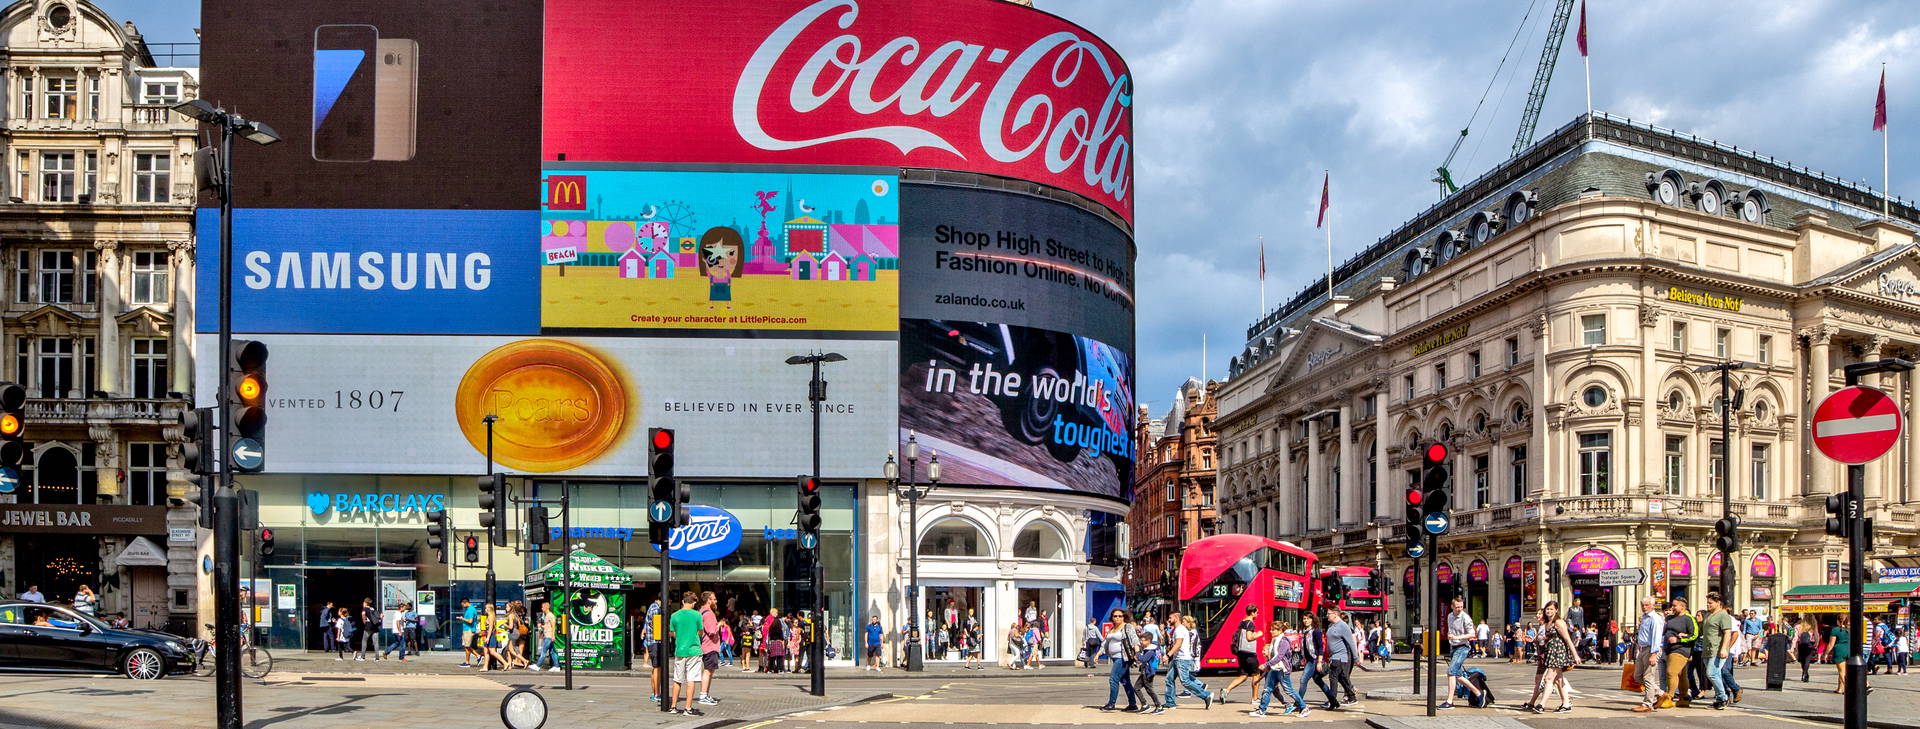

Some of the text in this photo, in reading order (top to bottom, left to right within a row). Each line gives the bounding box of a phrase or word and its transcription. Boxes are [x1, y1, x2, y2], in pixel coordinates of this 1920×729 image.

[733, 0, 1132, 203] Coca-Cola
[548, 249, 576, 261] BEACH
[935, 225, 990, 250] Shop
[997, 231, 1040, 255] High
[1046, 238, 1089, 266] Street
[1093, 252, 1104, 271] to
[245, 250, 491, 291] SAMSUNG
[936, 250, 1017, 276] Fashion
[1024, 261, 1080, 289] Online.
[1084, 274, 1100, 295] No
[935, 292, 1025, 311] zalando.co.uk
[1670, 287, 1703, 305] Believe
[1704, 292, 1714, 306] It
[1713, 298, 1724, 308] or
[631, 315, 660, 323] Create
[663, 316, 682, 324] your
[684, 315, 726, 323] character
[740, 316, 807, 324] LittlePicca.com
[926, 360, 1112, 412] in the world's
[269, 390, 404, 412] VENTED 1807
[664, 402, 735, 412] BELIEVED
[743, 403, 758, 412] IN
[766, 403, 802, 413] EVER
[1054, 413, 1129, 458] toughest
[335, 493, 445, 513] BARCLAYS
[1849, 501, 1857, 510] S
[2, 511, 91, 527] JEWEL BAR
[667, 515, 730, 551] Boots
[1888, 568, 1909, 576] MONEY
[1213, 585, 1228, 596] 38
